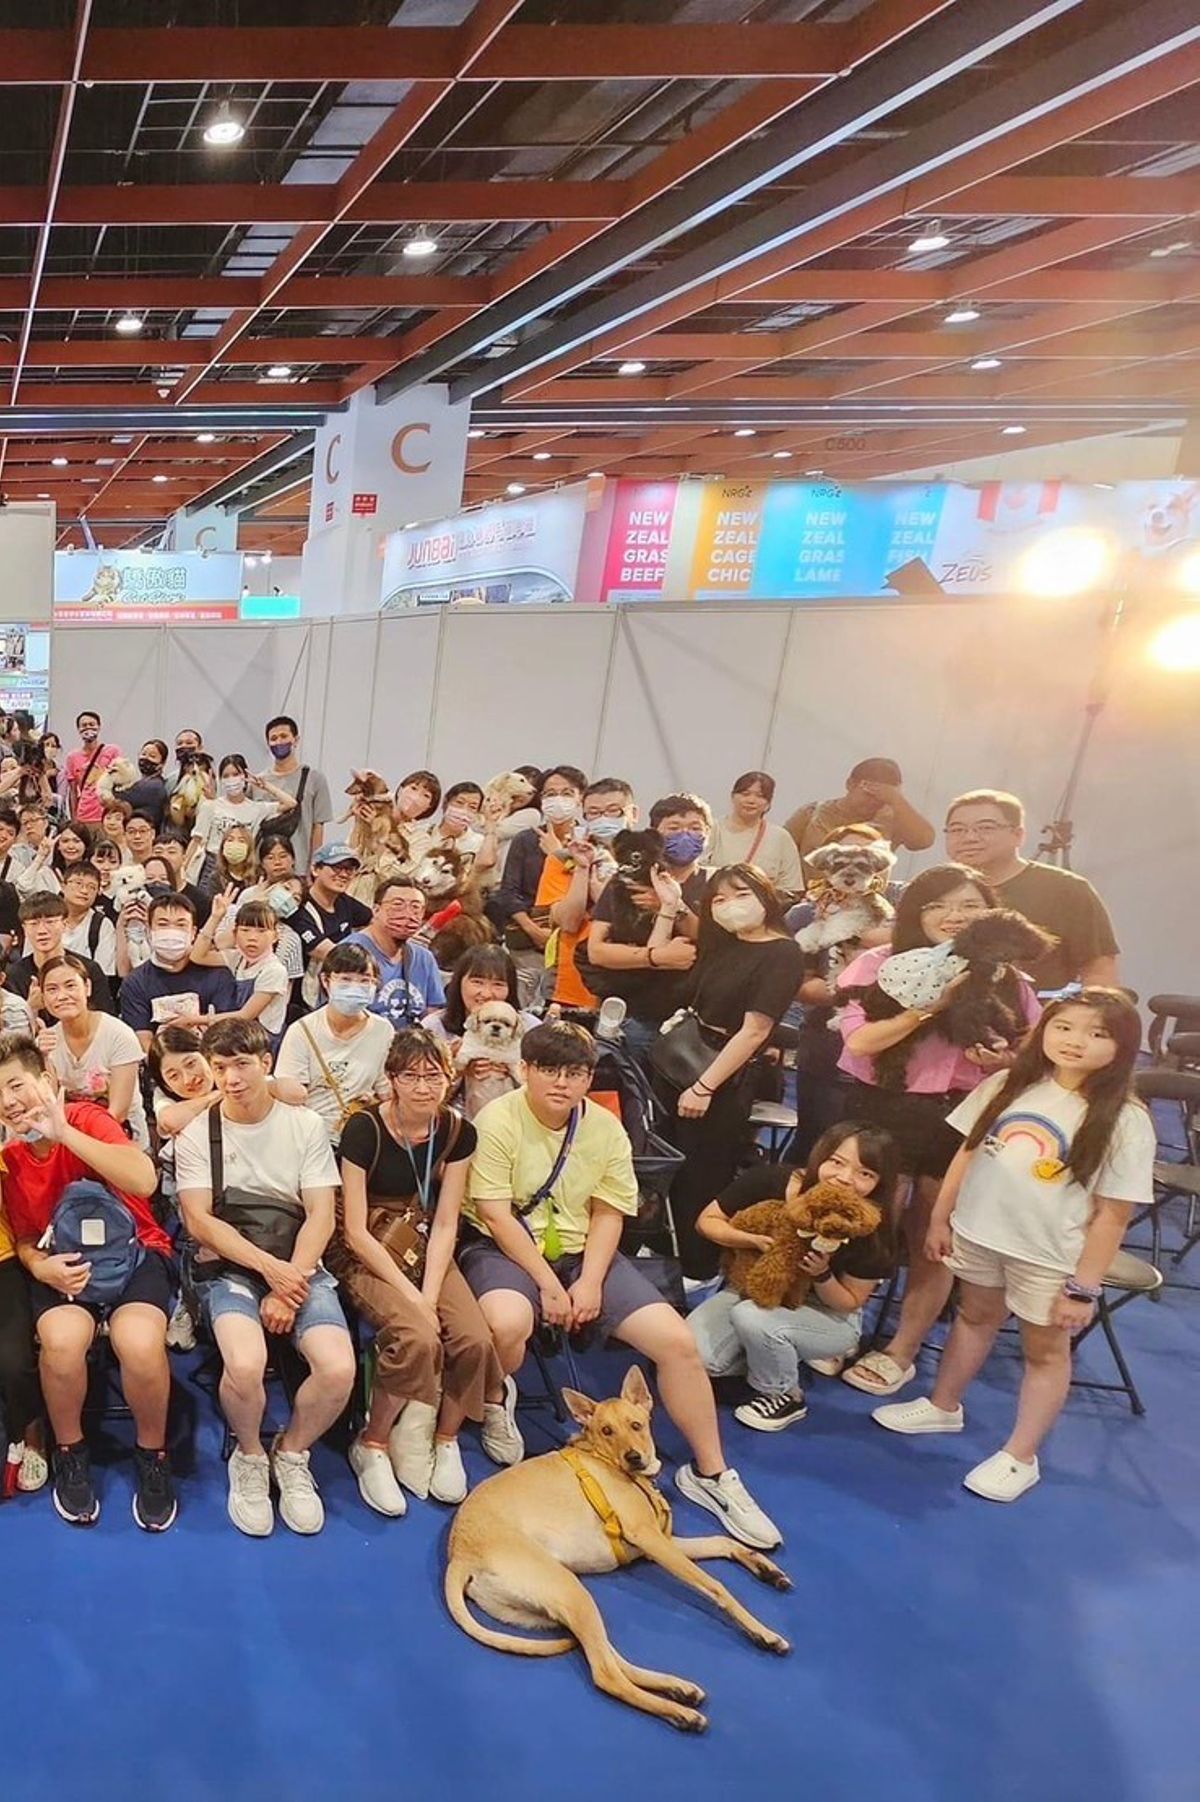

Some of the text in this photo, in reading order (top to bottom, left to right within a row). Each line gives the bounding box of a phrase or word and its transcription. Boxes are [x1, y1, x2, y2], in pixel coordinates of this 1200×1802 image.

[391, 422, 432, 473] C
[326, 433, 341, 484] C
[629, 511, 670, 526] NEW
[716, 511, 757, 526] NEW
[805, 511, 848, 526] NEW
[895, 511, 936, 526] NEW
[196, 526, 218, 552] C
[625, 530, 668, 545] ZEAL
[713, 530, 757, 545] ZEAL
[801, 530, 845, 545] ZEAL
[890, 530, 934, 545] ZEAL
[620, 567, 665, 582] BEEF
[940, 562, 993, 583] ZEUS
